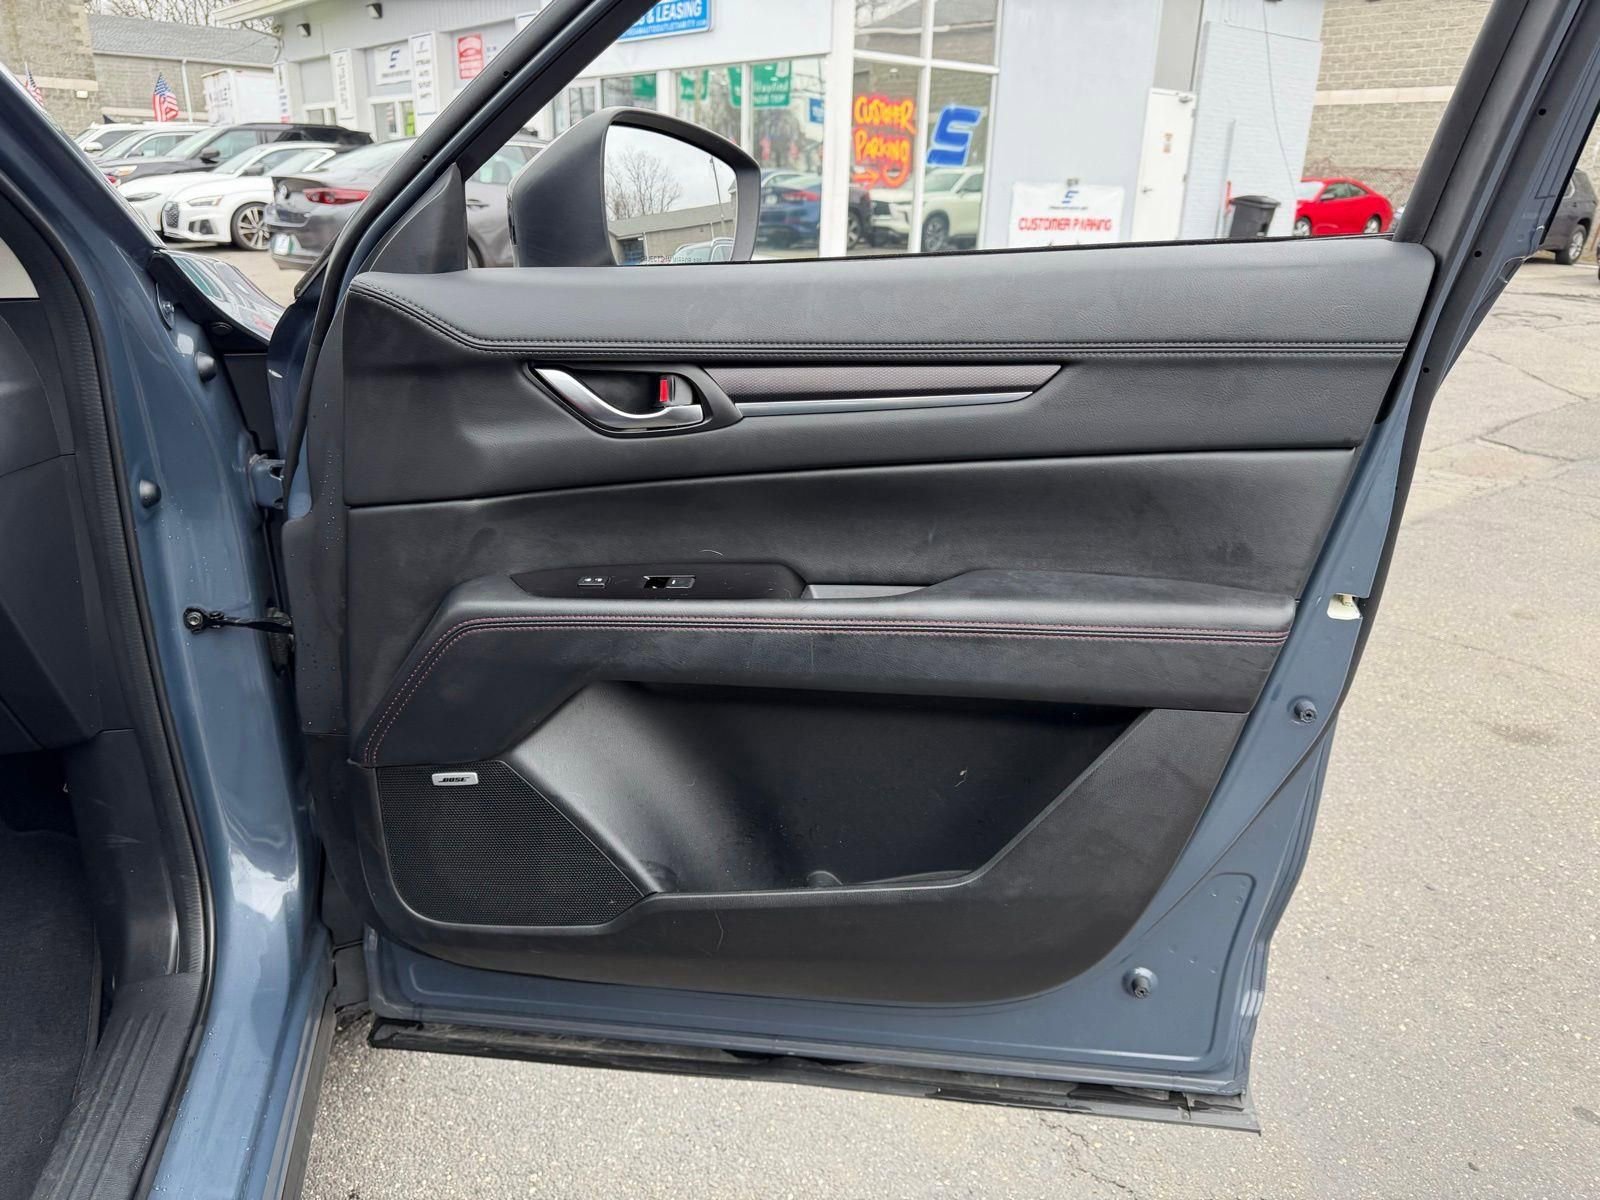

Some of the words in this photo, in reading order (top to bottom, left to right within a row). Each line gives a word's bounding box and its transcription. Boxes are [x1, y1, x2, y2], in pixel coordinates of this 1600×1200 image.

[656, 1, 703, 22] LEASING
[1018, 217, 1071, 231] CUSTOMER
[1073, 217, 1112, 232] PARKING
